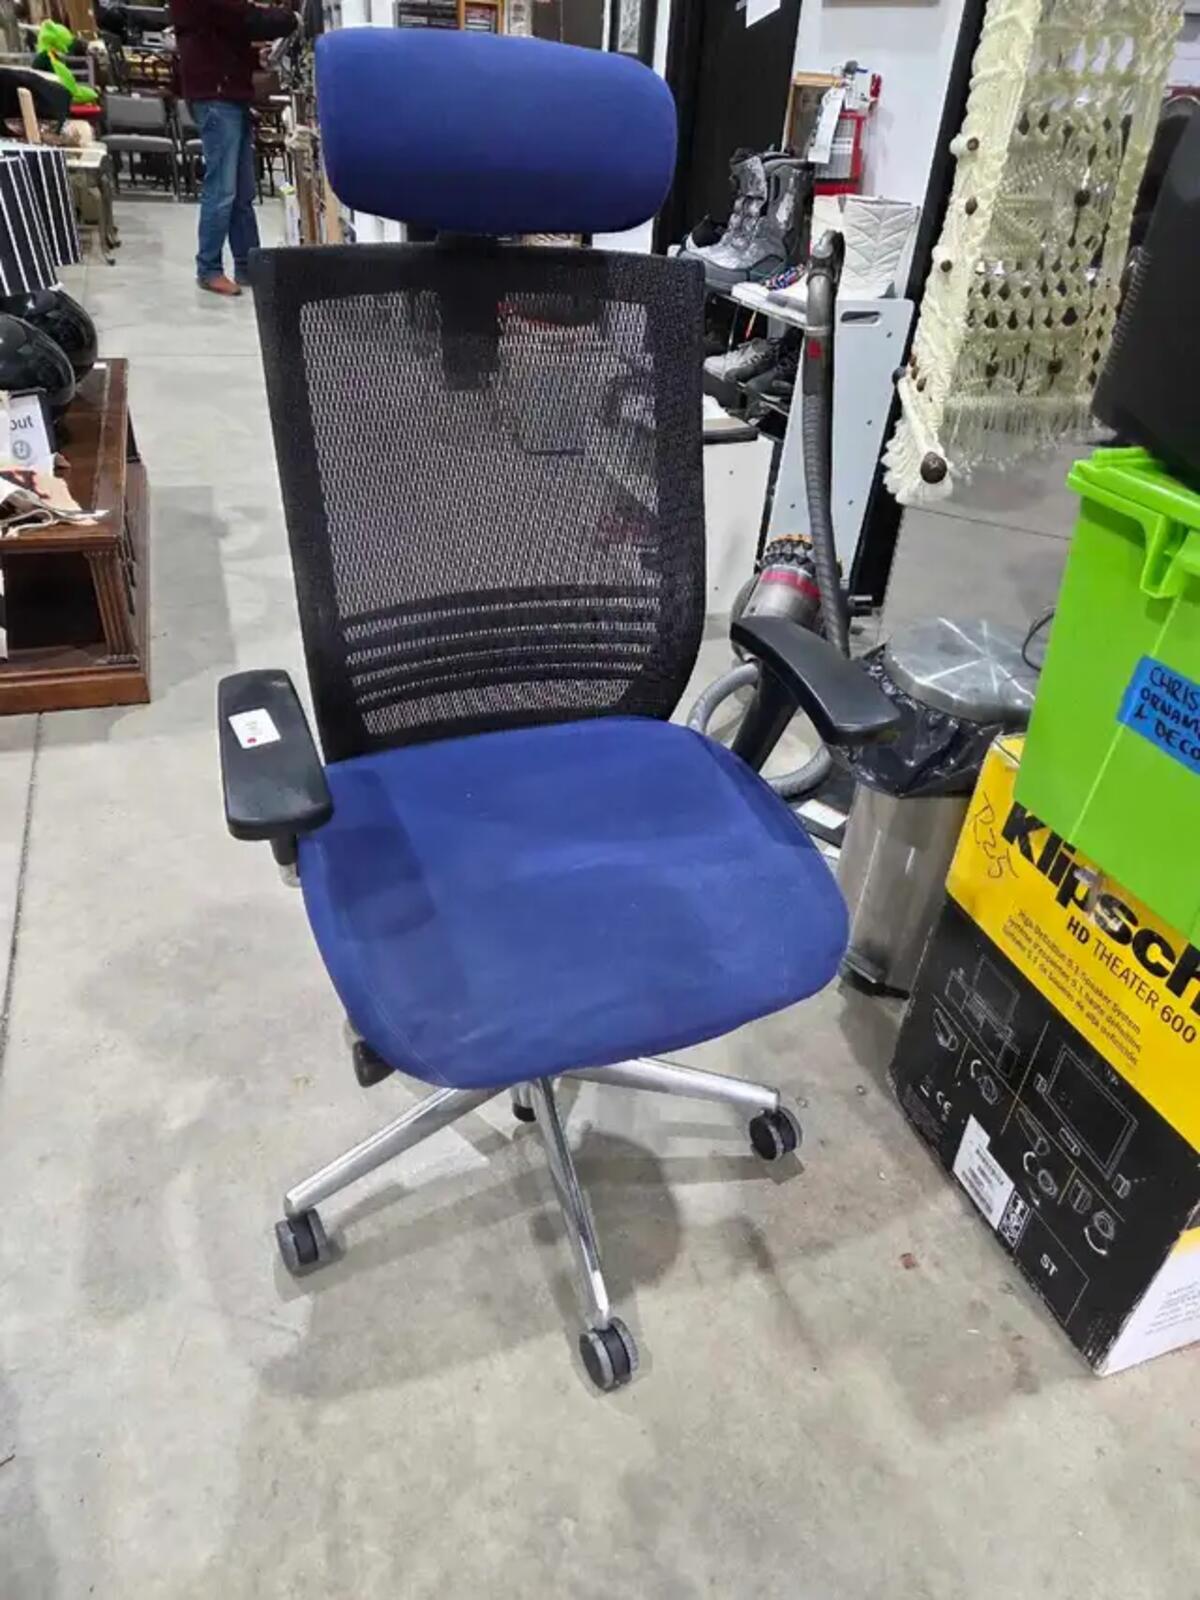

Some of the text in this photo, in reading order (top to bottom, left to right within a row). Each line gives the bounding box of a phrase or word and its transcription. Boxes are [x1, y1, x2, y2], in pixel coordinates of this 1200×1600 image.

[1067, 915, 1197, 1044] HD THEATER 600
[1040, 1253, 1058, 1276] ST
